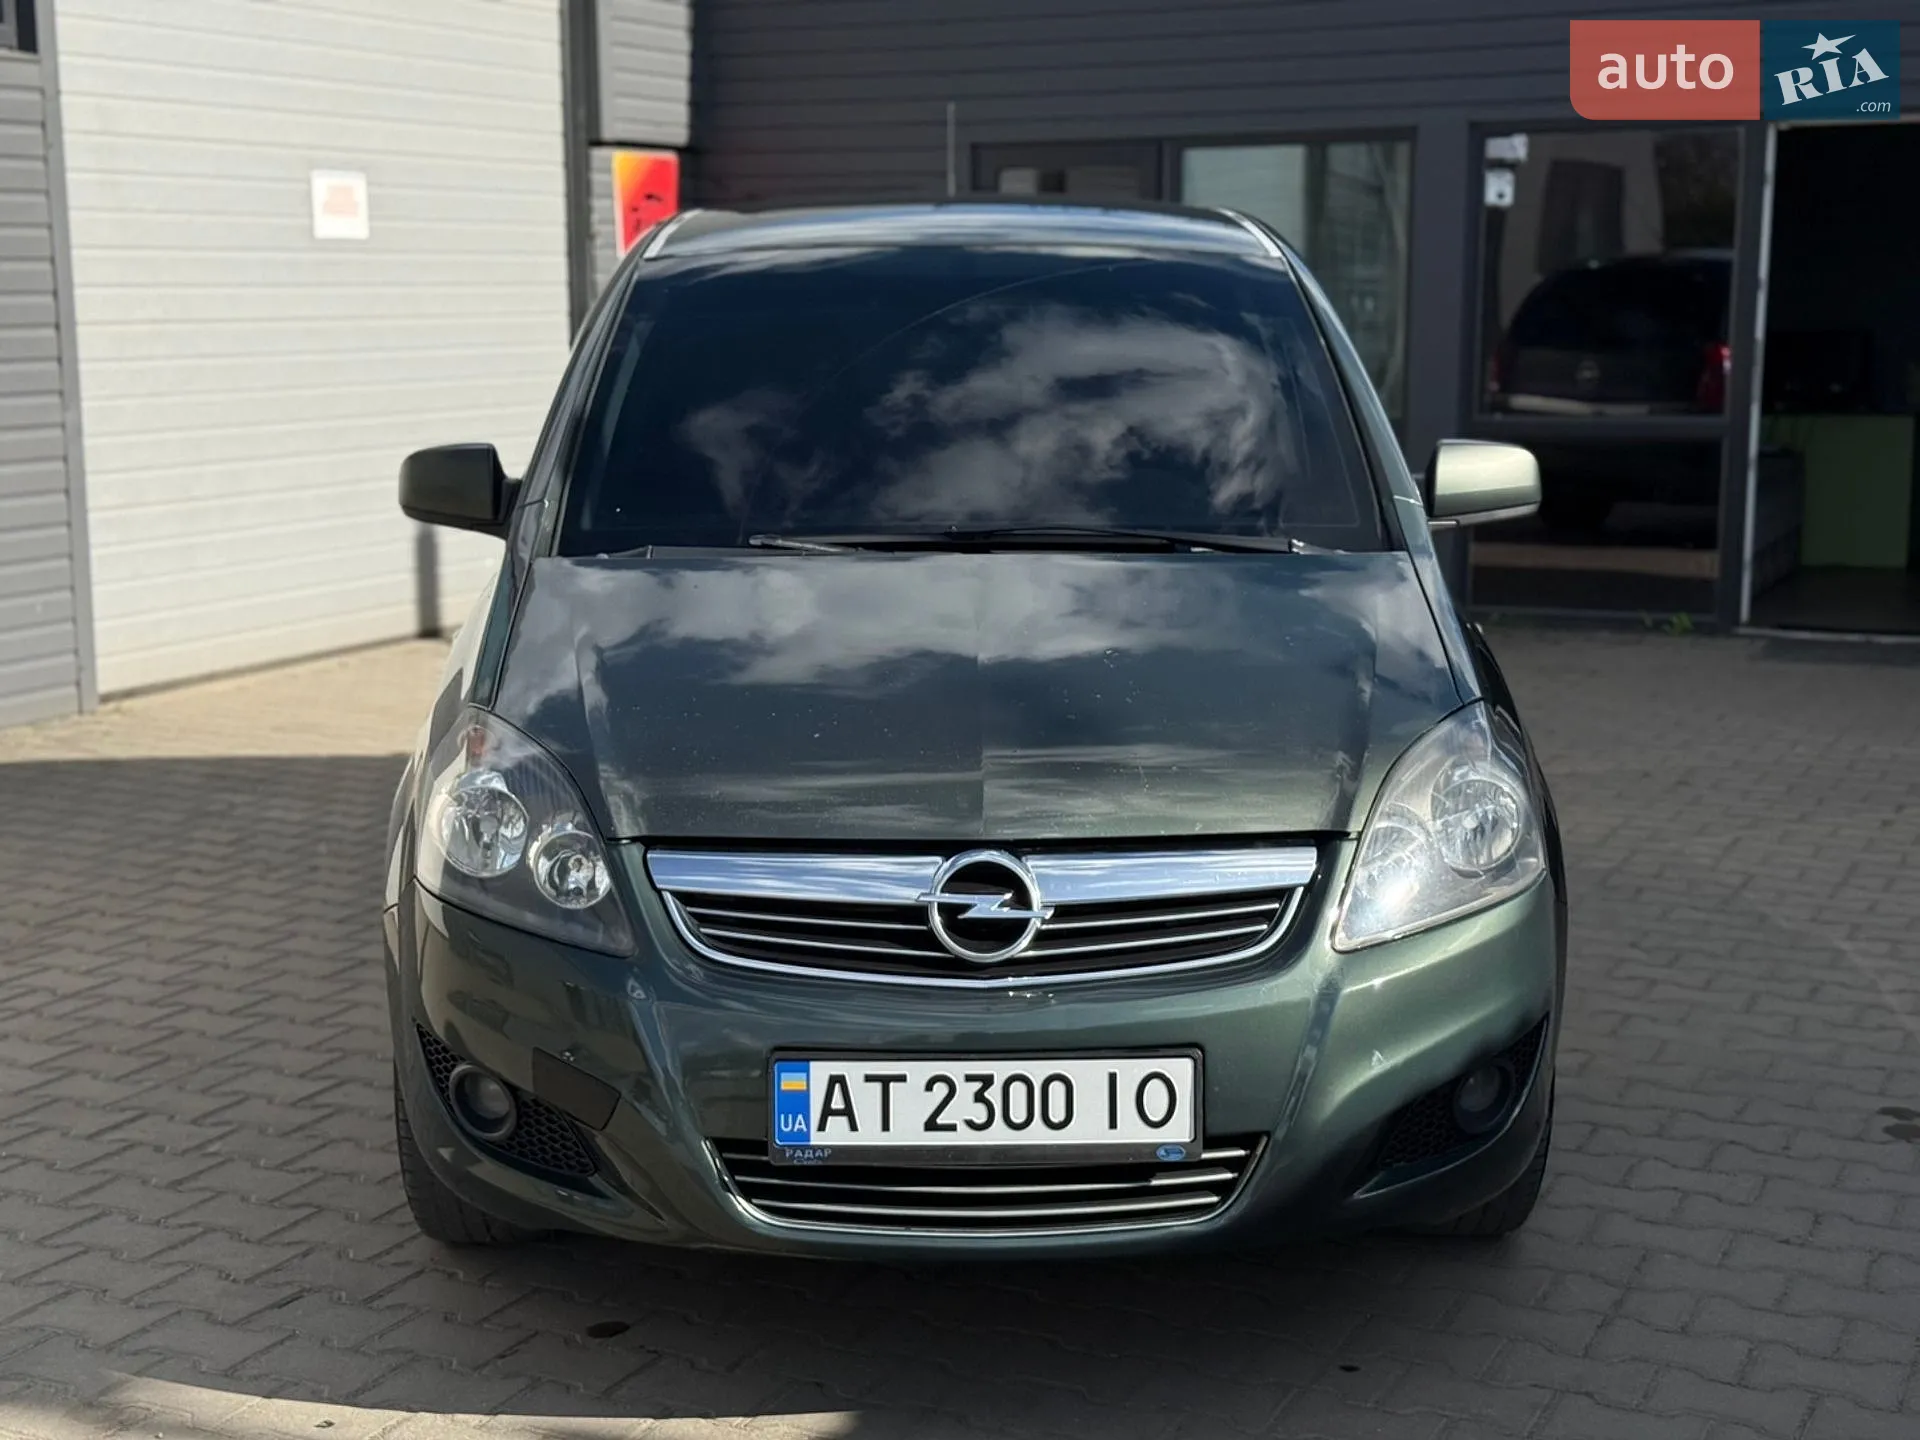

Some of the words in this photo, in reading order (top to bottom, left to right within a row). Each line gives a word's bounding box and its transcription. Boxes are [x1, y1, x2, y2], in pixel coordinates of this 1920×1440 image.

[816, 1073, 908, 1132] AT
[923, 1072, 1075, 1132] 2300
[1108, 1071, 1178, 1130] IO
[780, 1113, 807, 1132] UA
